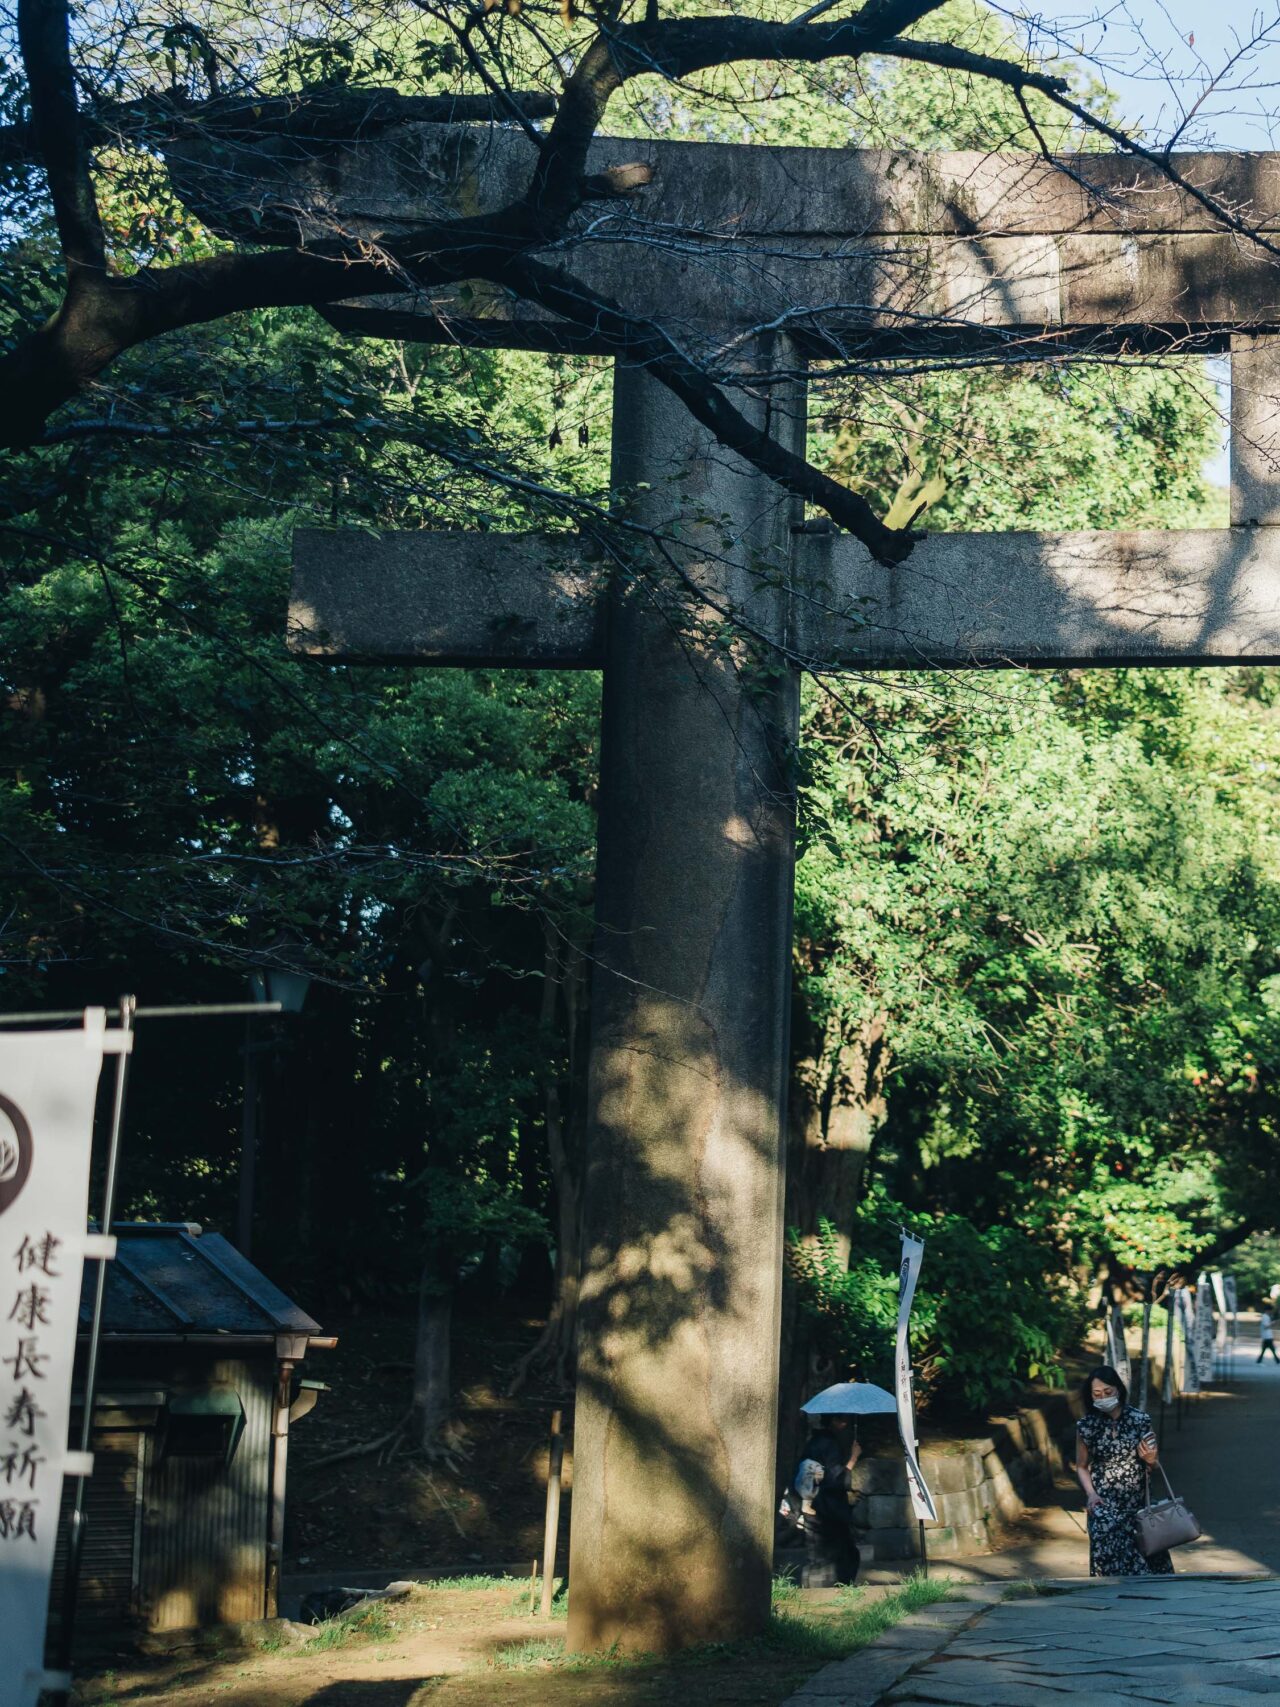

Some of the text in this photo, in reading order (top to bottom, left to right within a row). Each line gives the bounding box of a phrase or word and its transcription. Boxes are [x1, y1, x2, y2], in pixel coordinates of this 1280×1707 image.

[0, 1231, 63, 1541] 健康長寿祈願
